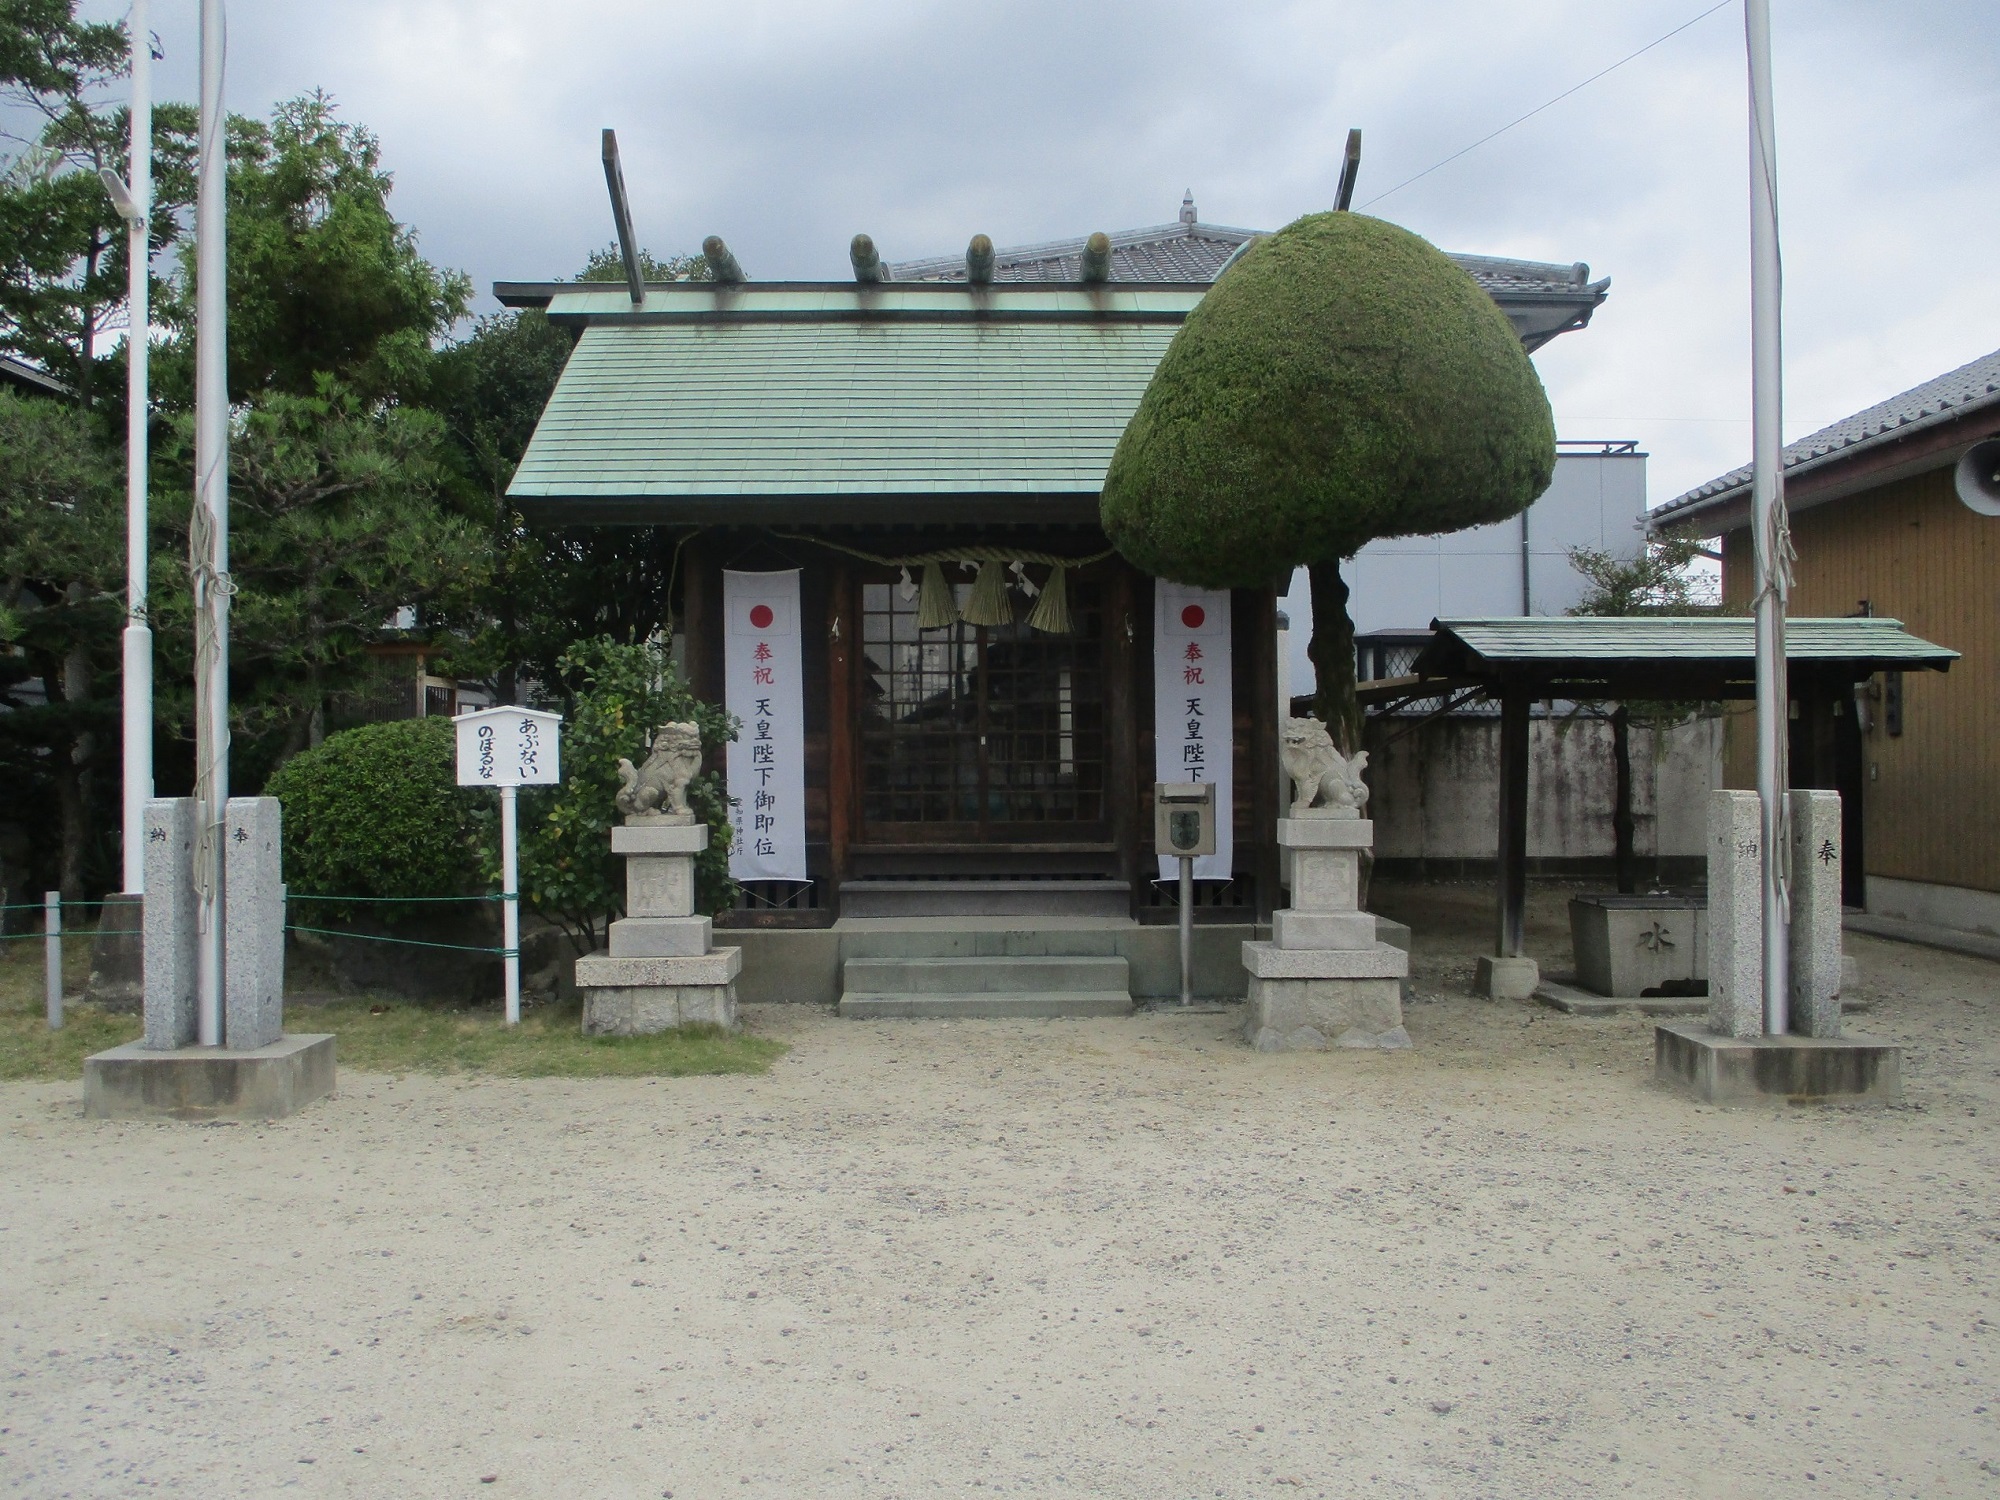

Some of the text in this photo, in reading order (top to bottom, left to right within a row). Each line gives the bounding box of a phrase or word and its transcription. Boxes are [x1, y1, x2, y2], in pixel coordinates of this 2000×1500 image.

[1183, 641, 1205, 685] 奉祝
[478, 725, 496, 779] のぼるな
[519, 718, 540, 779] あぶない
[753, 642, 776, 857] 奉祝 天皇陛下御即位
[233, 827, 250, 844] 奉
[1738, 839, 1758, 859] 納
[1818, 839, 1838, 867] 奉
